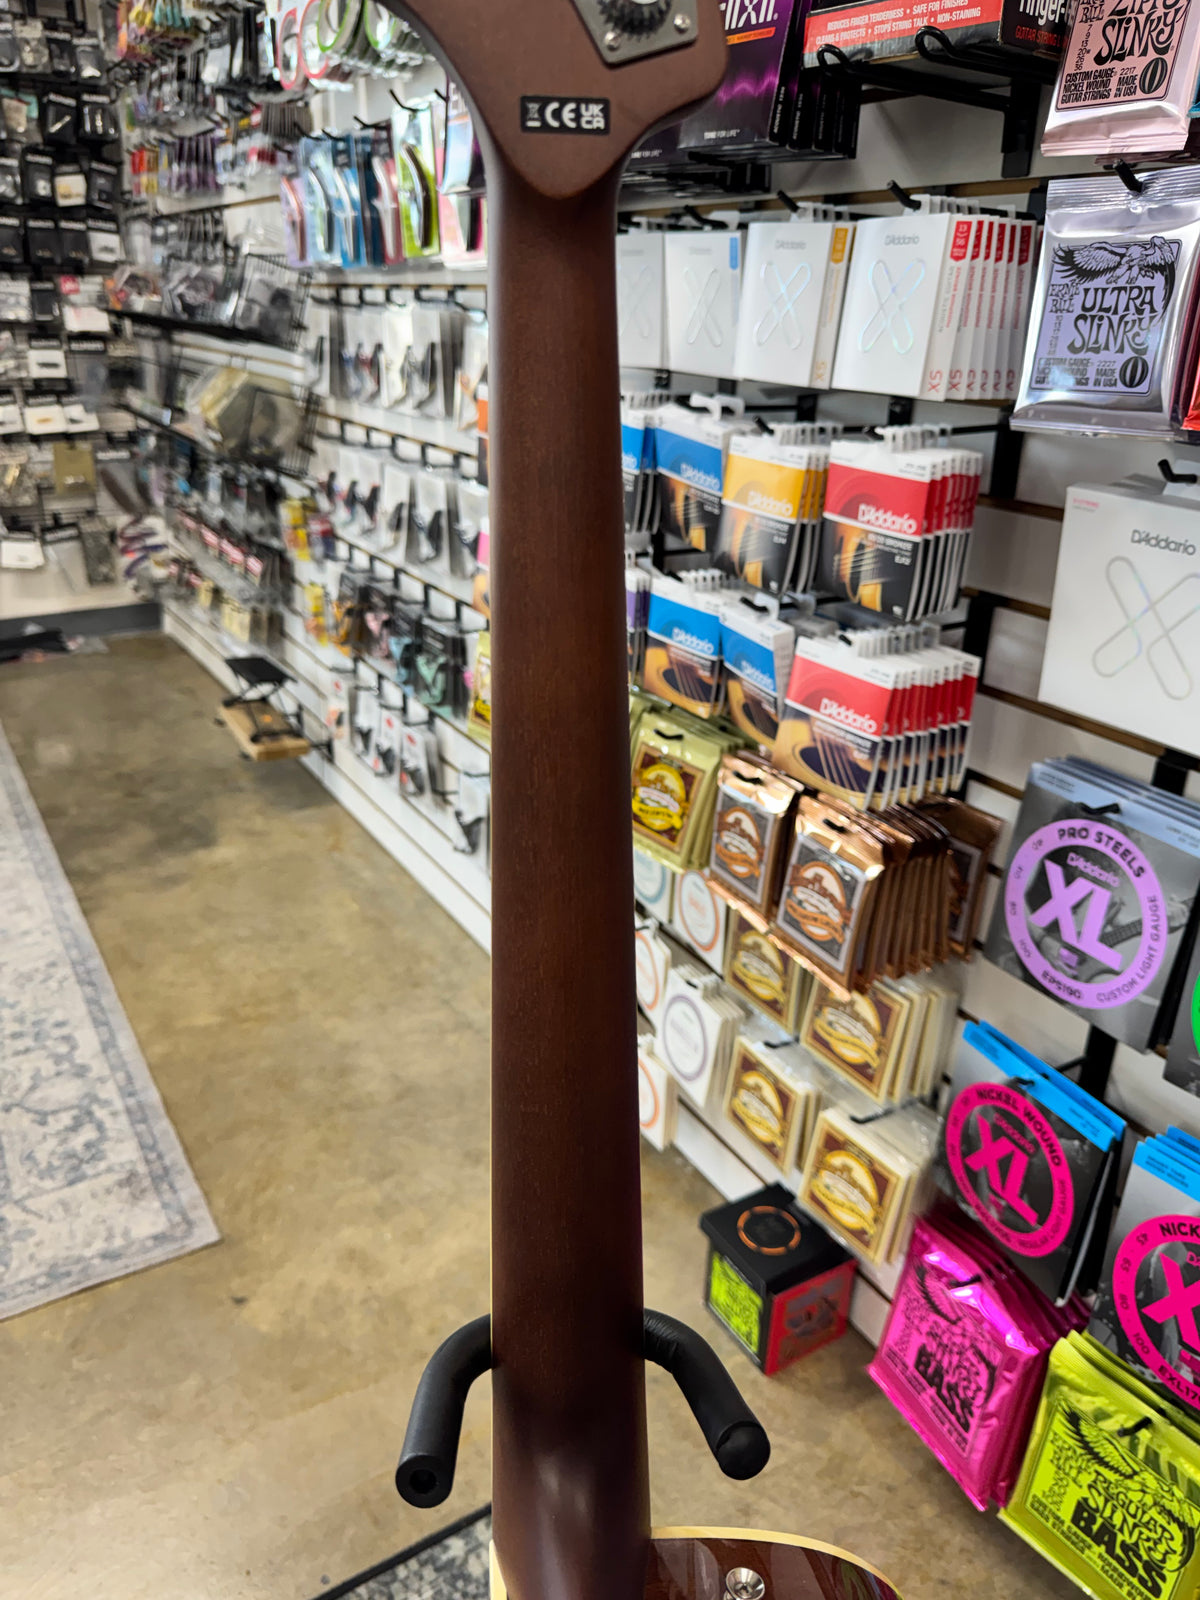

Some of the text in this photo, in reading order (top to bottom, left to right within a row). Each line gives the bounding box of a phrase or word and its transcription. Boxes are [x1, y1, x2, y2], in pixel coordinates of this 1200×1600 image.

[816, 33, 834, 45] CLEANS
[840, 28, 866, 41] PROTECTS
[873, 23, 891, 34] STOPS
[892, 19, 912, 31] STRING
[913, 16, 928, 26] TALK
[937, 7, 981, 23] NON-STAINING
[827, 0, 968, 31] REDUCES FINGER TENDERNESS SAFE FOR FINISHES
[1094, 6, 1184, 66] SLINKY
[1063, 79, 1111, 93] NICKEL WOUND
[1065, 67, 1115, 83] CUSTOM GAUGE
[1114, 85, 1137, 98] IN USA
[1117, 74, 1138, 87] MADE
[1061, 89, 1111, 104] GUITAR STRINGS
[1049, 279, 1080, 298] ERNIE
[1081, 285, 1158, 315] ULTRA
[1049, 298, 1074, 313] BALL
[1067, 313, 1157, 356] SLINKY
[1096, 368, 1117, 378] MADE
[1103, 378, 1117, 387] USA
[858, 503, 917, 535] D'Addario
[1131, 529, 1197, 556] D'Addario
[673, 627, 714, 654] D'Addario
[820, 697, 877, 734] D'Addario
[1057, 827, 1089, 840] PRO
[1094, 831, 1145, 878] STEELS
[1067, 852, 1119, 887] D'Addario
[1030, 859, 1123, 971] XL
[1096, 896, 1160, 1003] CUSTOM LIGHT GAUGE
[1024, 1107, 1062, 1167] WOUND
[964, 1113, 1038, 1227] XL
[1133, 1333, 1150, 1355] 100
[914, 1344, 974, 1433] BASS
[1158, 1365, 1200, 1404] EXL17
[1080, 1483, 1168, 1571] SLINKY
[1094, 1469, 1176, 1554] REGULAR
[1071, 1497, 1167, 1599] BASS
